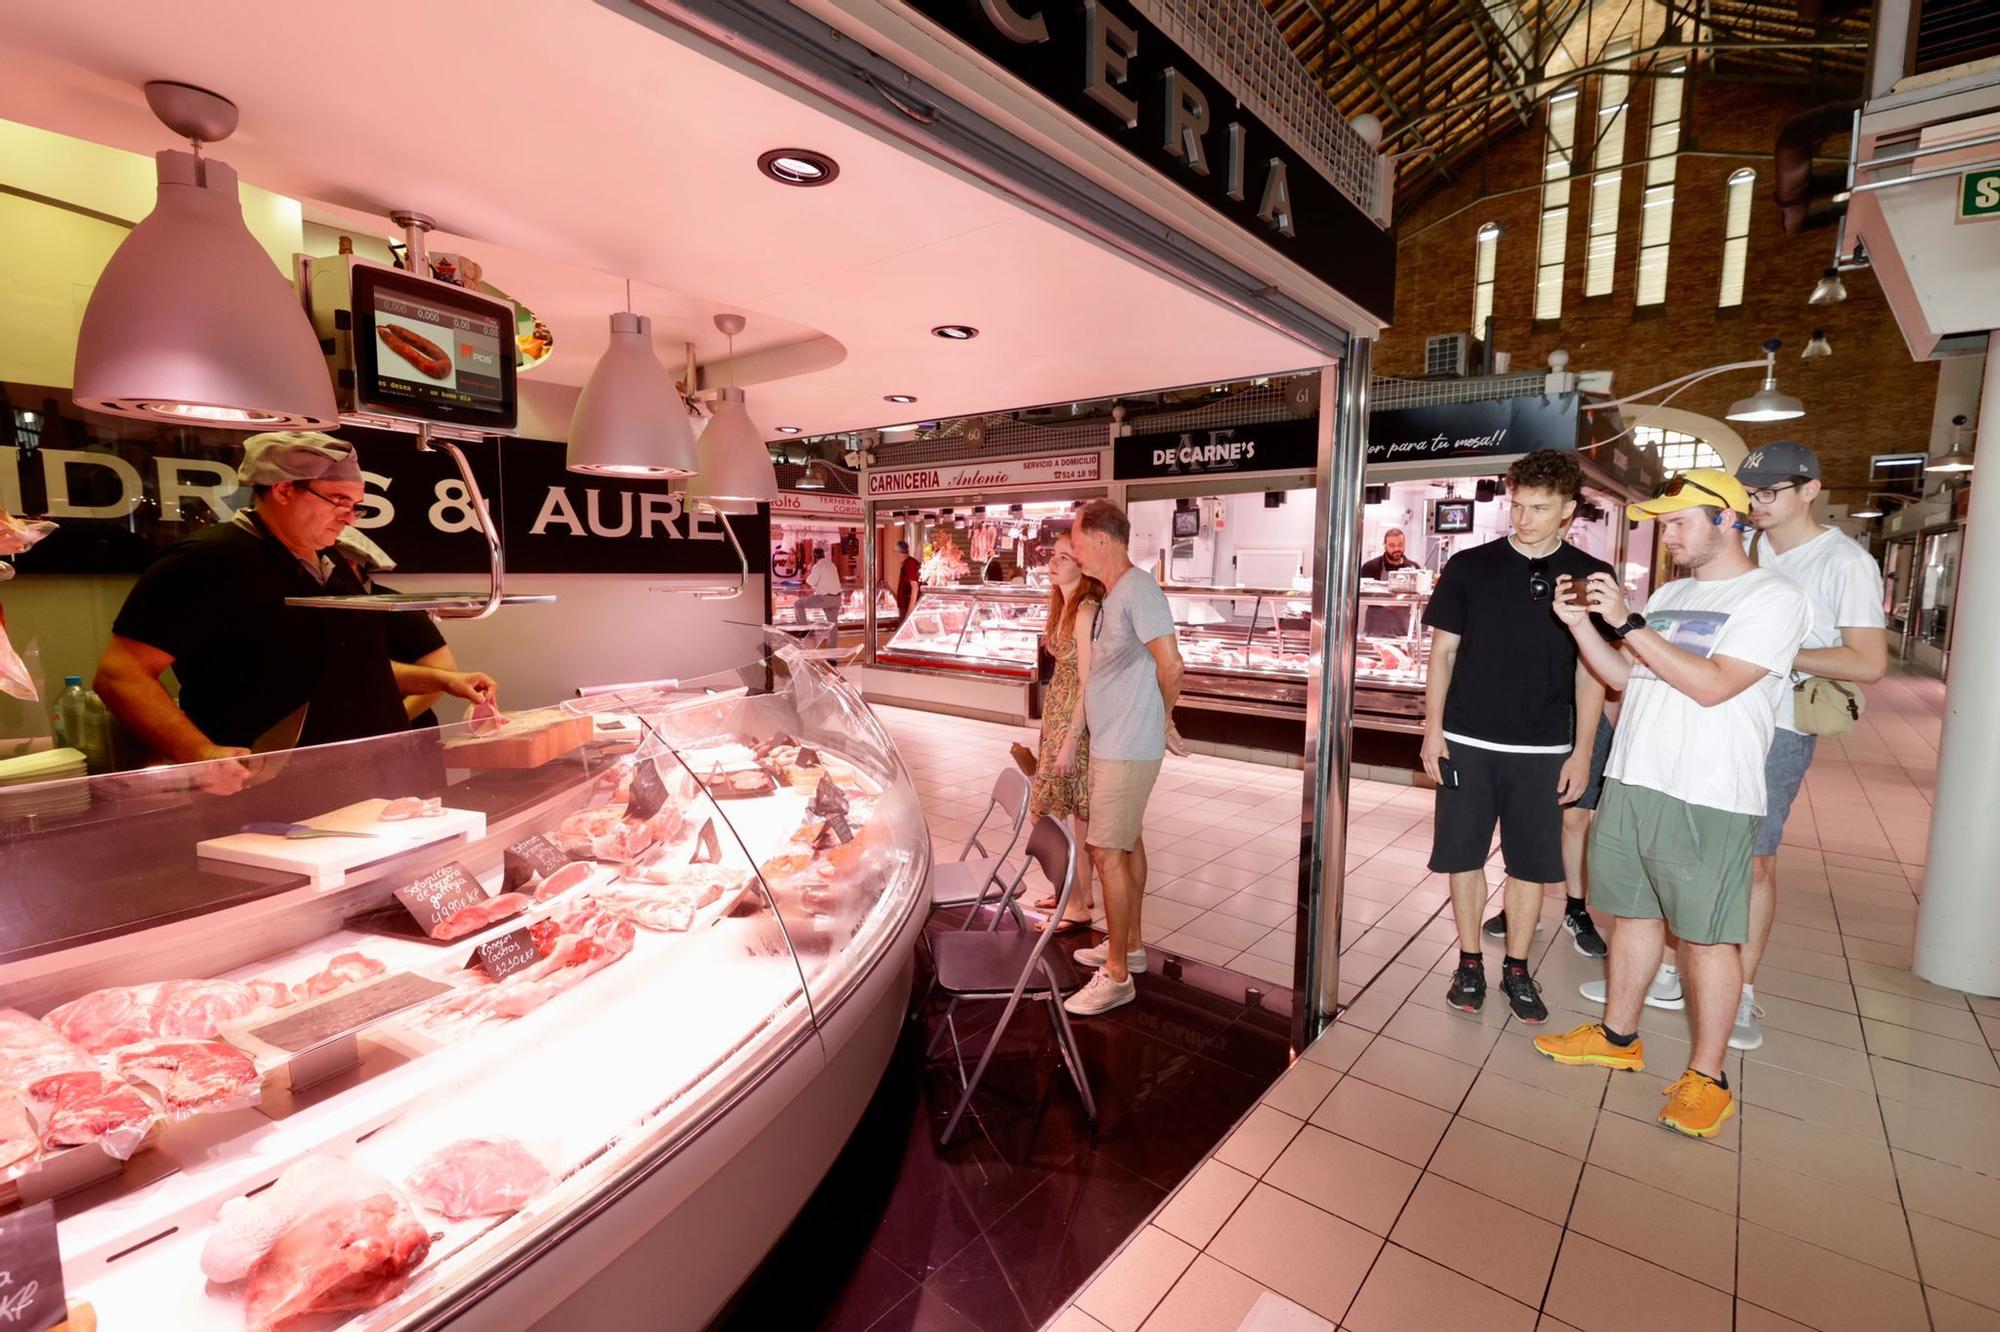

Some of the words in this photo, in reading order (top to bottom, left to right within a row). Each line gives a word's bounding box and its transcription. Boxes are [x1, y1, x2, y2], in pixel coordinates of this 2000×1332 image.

[968, 428, 980, 441] 60
[1367, 440, 1385, 454] or
[1386, 440, 1428, 459] para
[1431, 432, 1450, 452] tu
[1453, 428, 1508, 448] mesa!!
[1023, 460, 1053, 470] SERVICIO
[1061, 456, 1097, 467] DOMICILIO
[1153, 449, 1176, 466] DE
[870, 470, 940, 493] CARNICERIA
[947, 469, 1010, 488] Antonio
